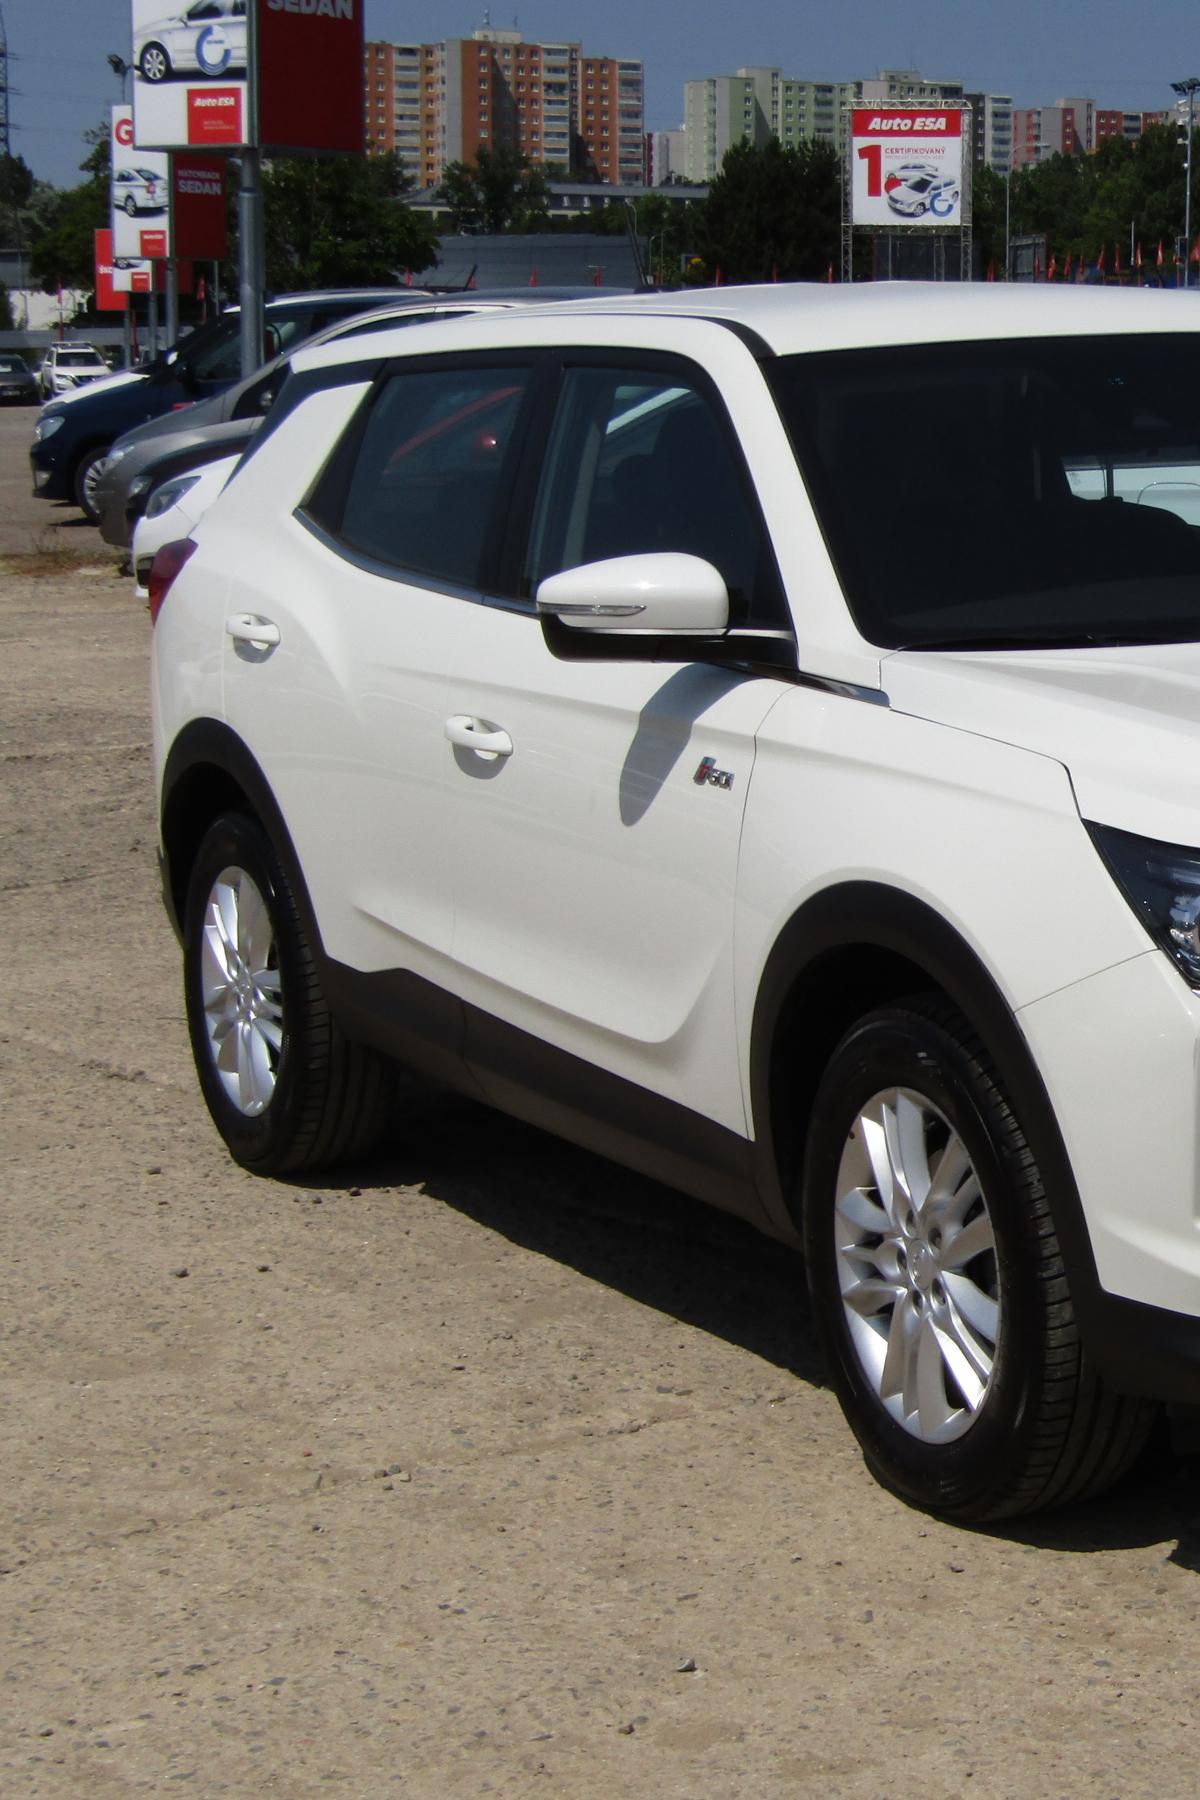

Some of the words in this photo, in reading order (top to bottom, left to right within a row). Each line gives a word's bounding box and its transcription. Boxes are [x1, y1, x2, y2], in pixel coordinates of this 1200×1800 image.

[868, 117, 911, 131] Auto
[913, 117, 946, 131] ESA
[858, 145, 881, 197] 1
[179, 180, 221, 195] SEDAN
